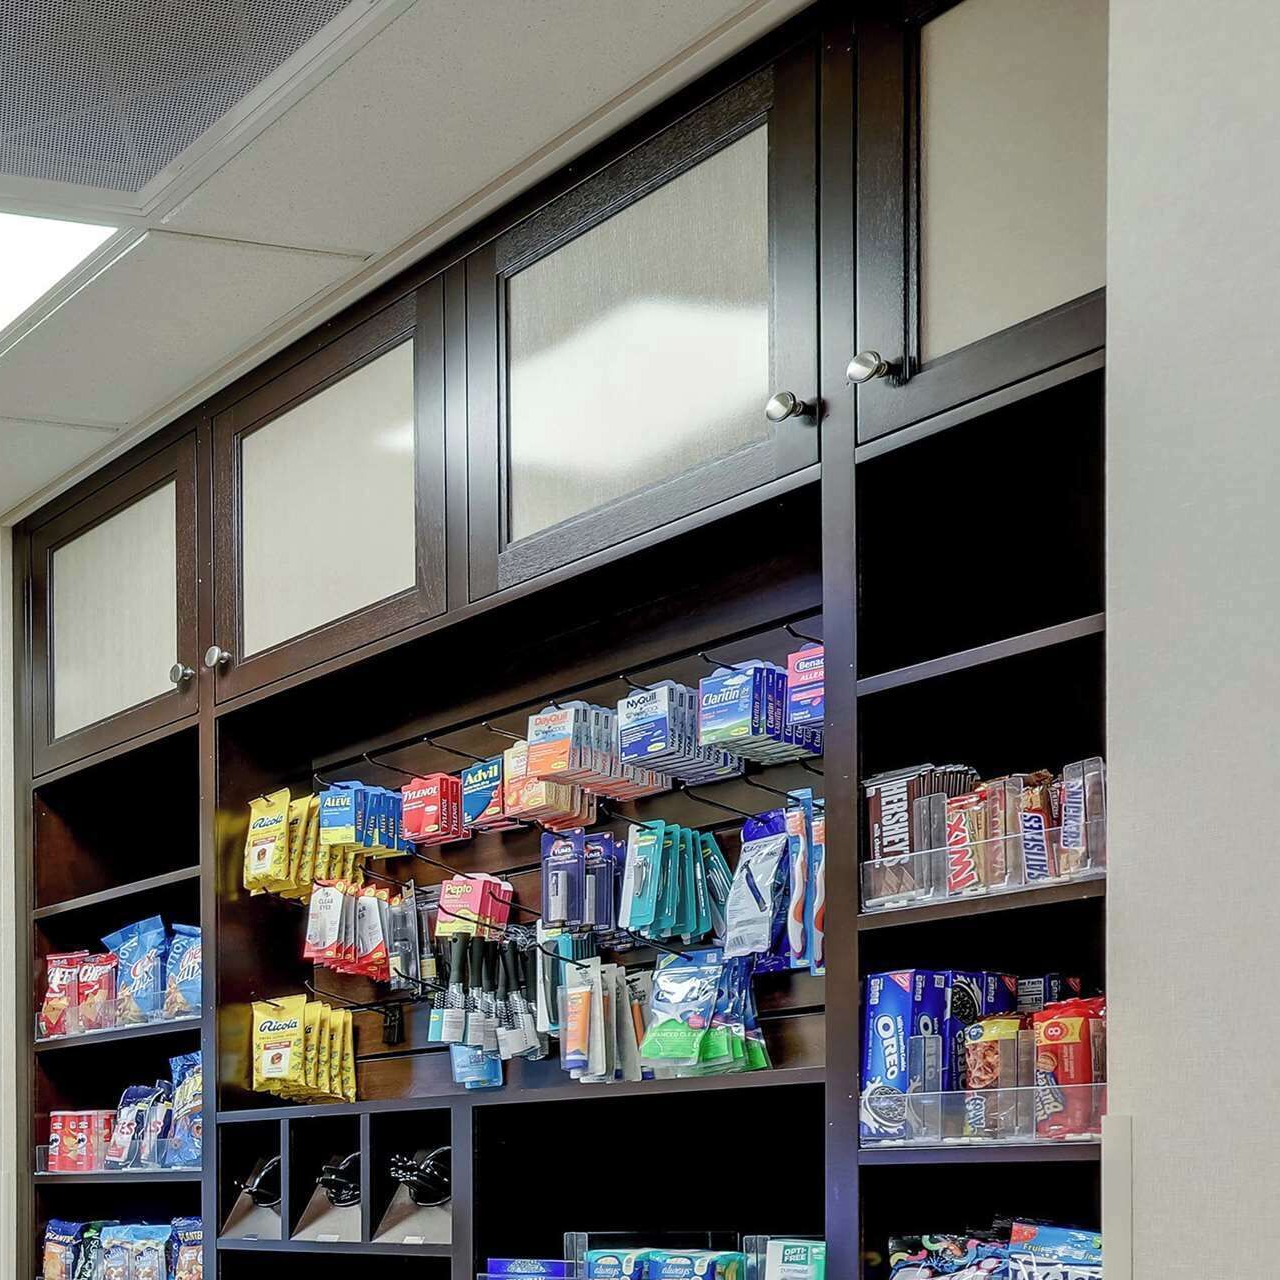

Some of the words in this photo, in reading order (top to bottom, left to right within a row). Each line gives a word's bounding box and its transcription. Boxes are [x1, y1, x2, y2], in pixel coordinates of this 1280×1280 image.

[798, 658, 824, 670] Bena
[801, 670, 824, 681] ALLER
[702, 685, 740, 706] Claritin
[464, 765, 499, 786] Advil
[402, 786, 439, 802] TYLENOL
[323, 797, 352, 808] ALEVE
[252, 815, 284, 830] Ricola
[880, 780, 911, 867] HERSHEY'S
[445, 883, 473, 897] Pepto
[259, 1018, 298, 1033] Ricola
[875, 1015, 898, 1080] OREO
[784, 1254, 807, 1262] FREE
[594, 1266, 621, 1276] always
[661, 1266, 692, 1276] always
